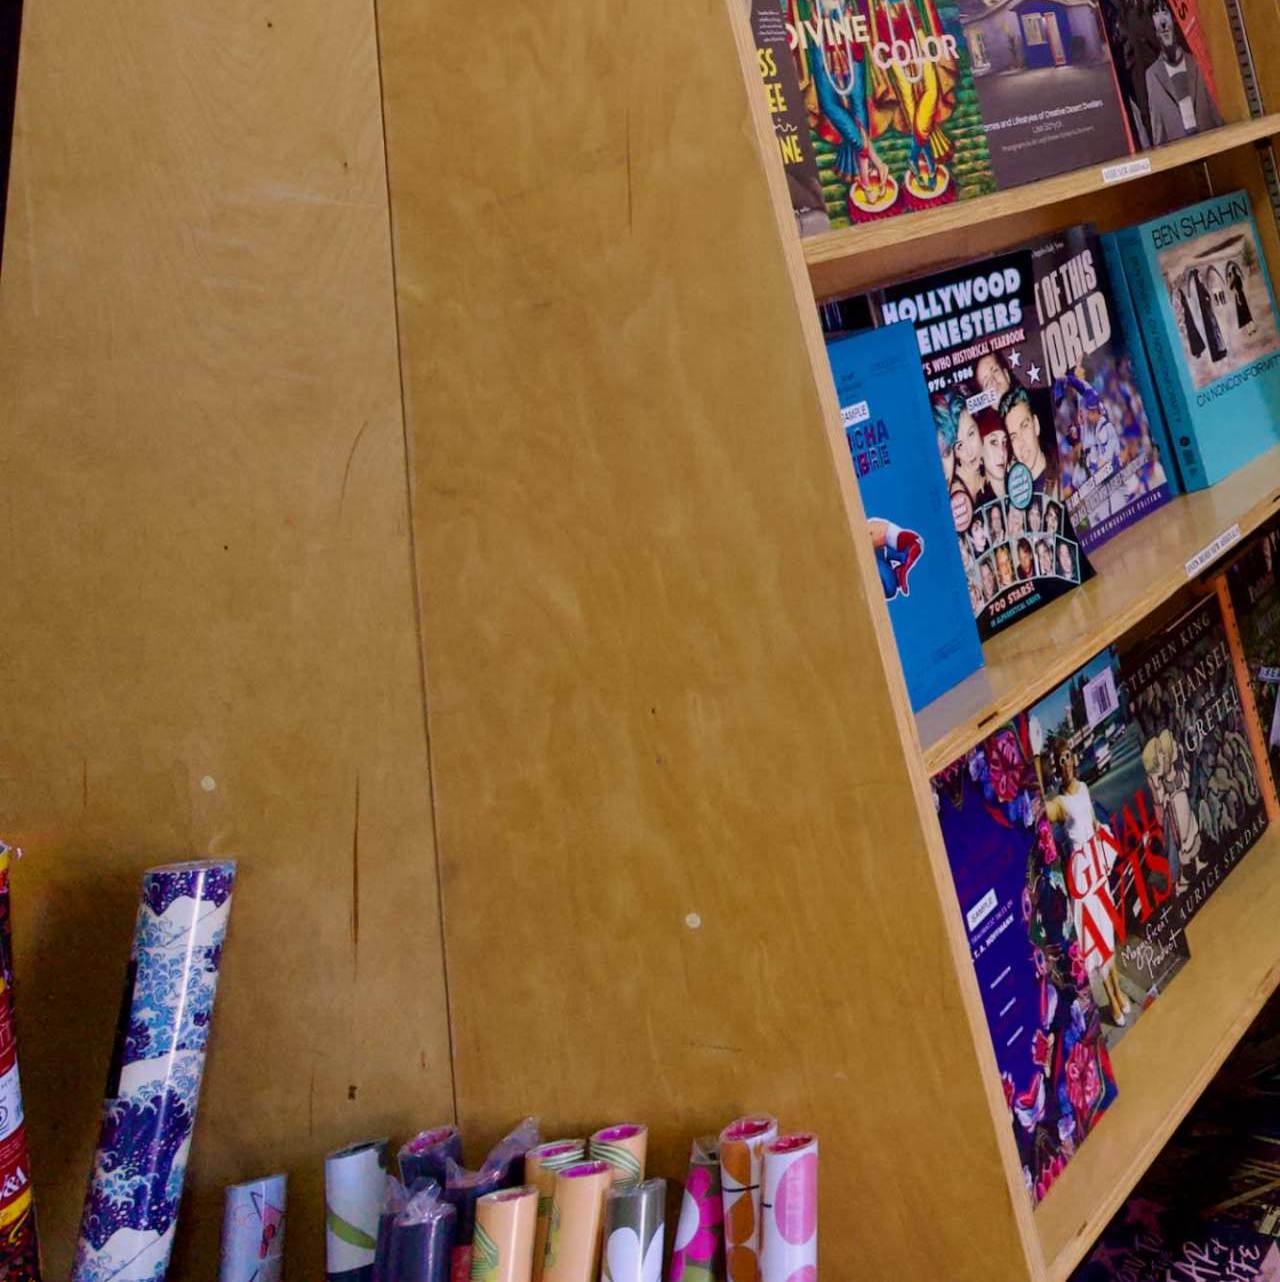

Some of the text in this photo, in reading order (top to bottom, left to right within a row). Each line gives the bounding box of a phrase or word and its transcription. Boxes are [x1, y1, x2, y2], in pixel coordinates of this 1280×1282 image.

[785, 14, 870, 50] DIVINE
[872, 34, 961, 70] COLOR
[1151, 201, 1249, 250] BEN SHAHN
[881, 268, 1020, 325] HOLLYWOOD
[1058, 250, 1098, 303] THIS
[915, 298, 1023, 355] ENESTERS
[932, 358, 952, 373] WHO
[951, 343, 990, 365] HISTORICAL
[990, 328, 1026, 350] YEARBOOK
[967, 389, 996, 410] SAMPLE
[1196, 391, 1211, 408] ON
[988, 581, 1035, 616] 700 STARS!
[1179, 612, 1211, 647] KING
[1171, 641, 1230, 709] HANSEL
[1184, 684, 1240, 752] GRETEL
